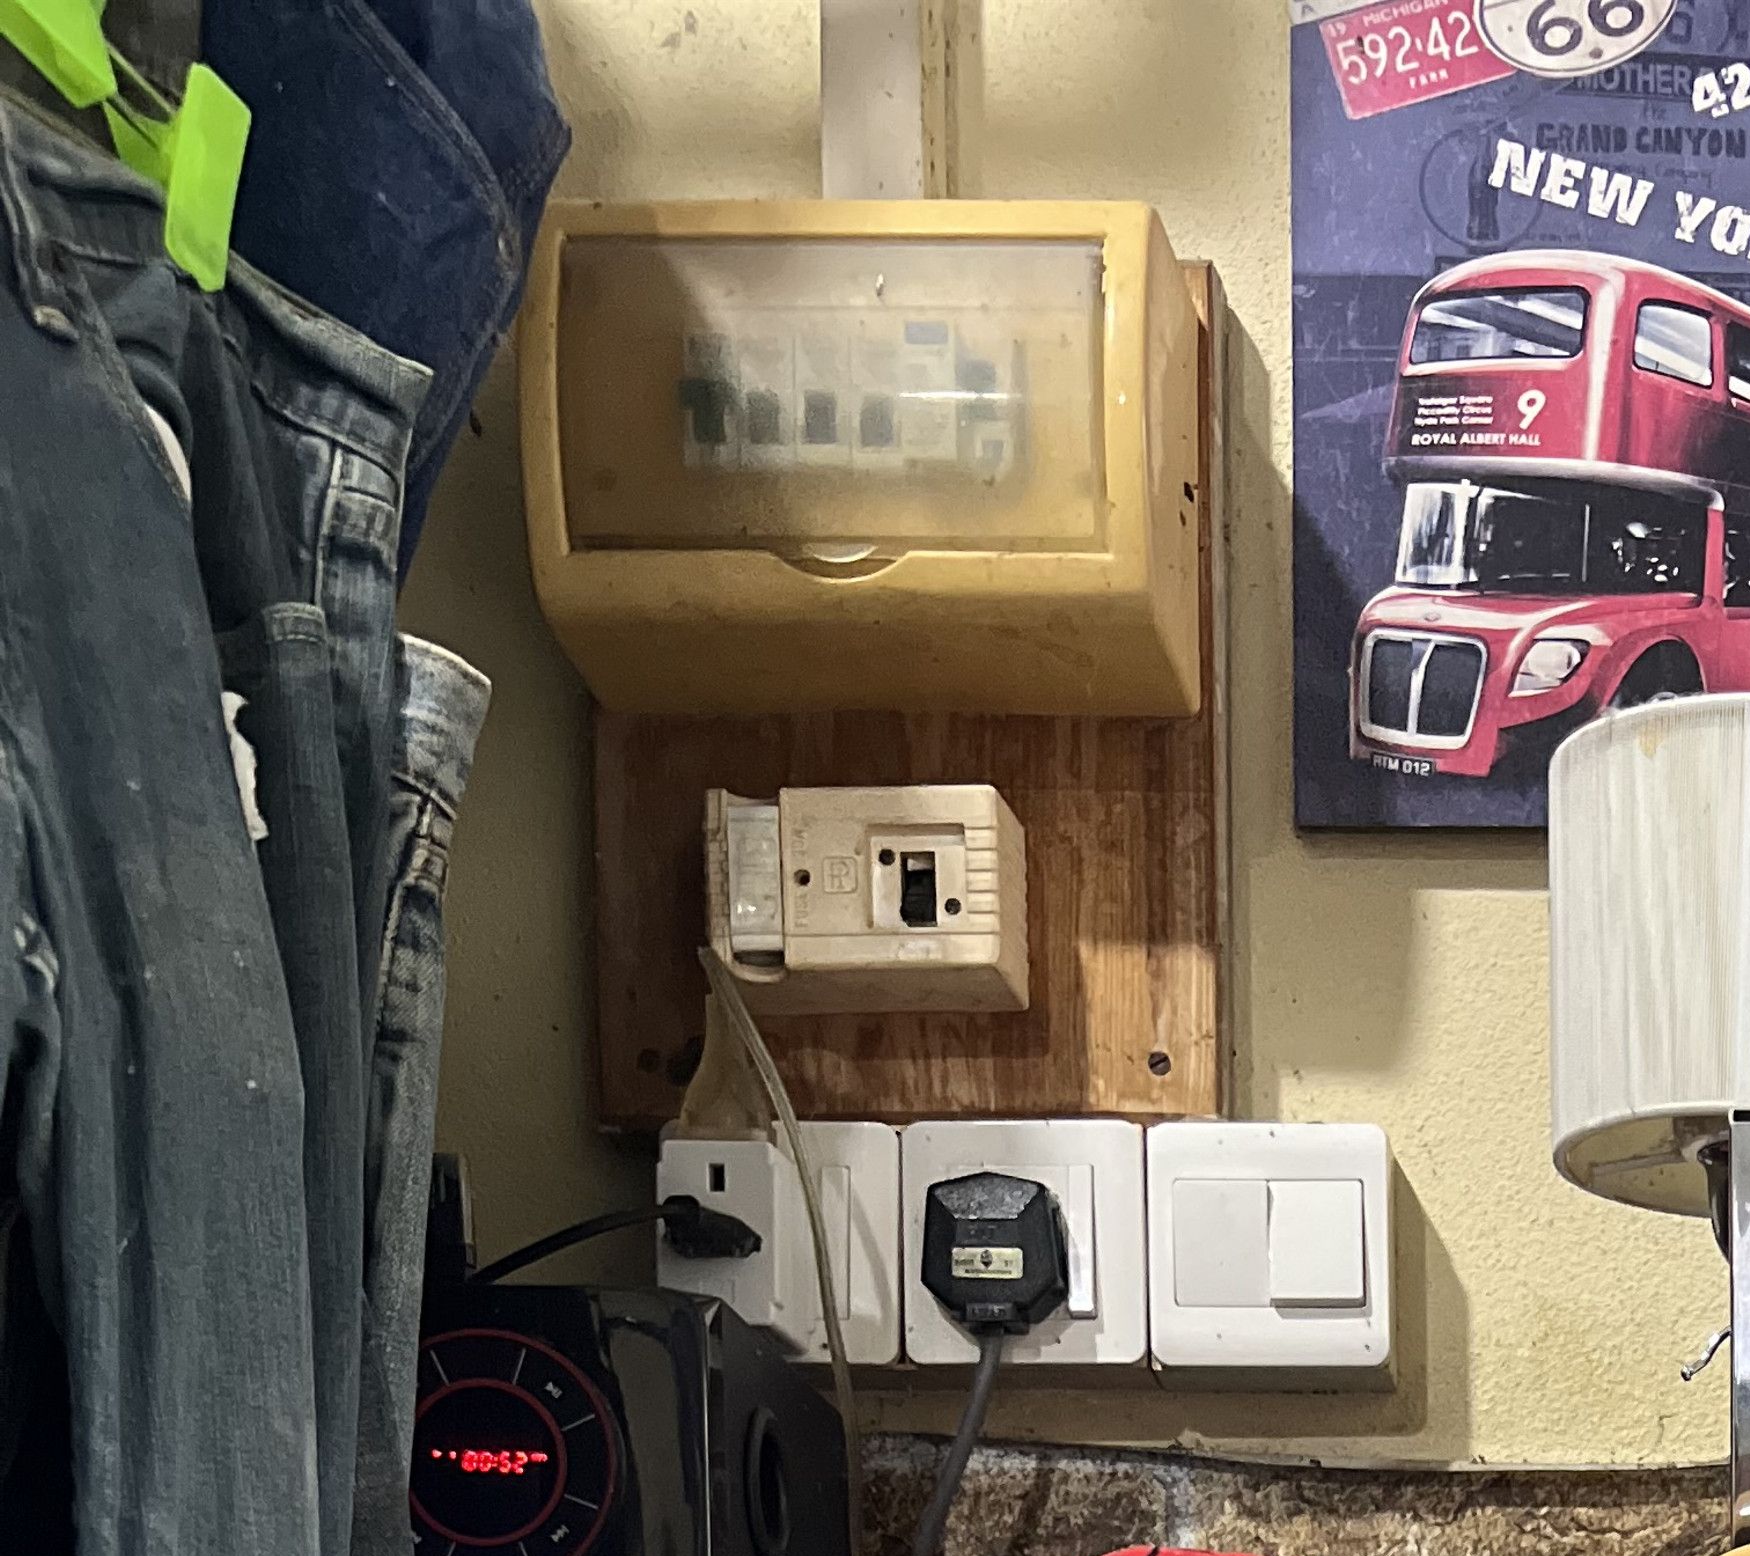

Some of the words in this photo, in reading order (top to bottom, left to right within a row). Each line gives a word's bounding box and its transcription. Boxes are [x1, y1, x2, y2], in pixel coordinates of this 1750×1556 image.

[1487, 138, 1655, 227] NEW
[1517, 389, 1547, 430] 9
[1411, 433, 1457, 446] ROYAL
[1460, 432, 1507, 445] ALBERT
[1508, 433, 1541, 446] HALL
